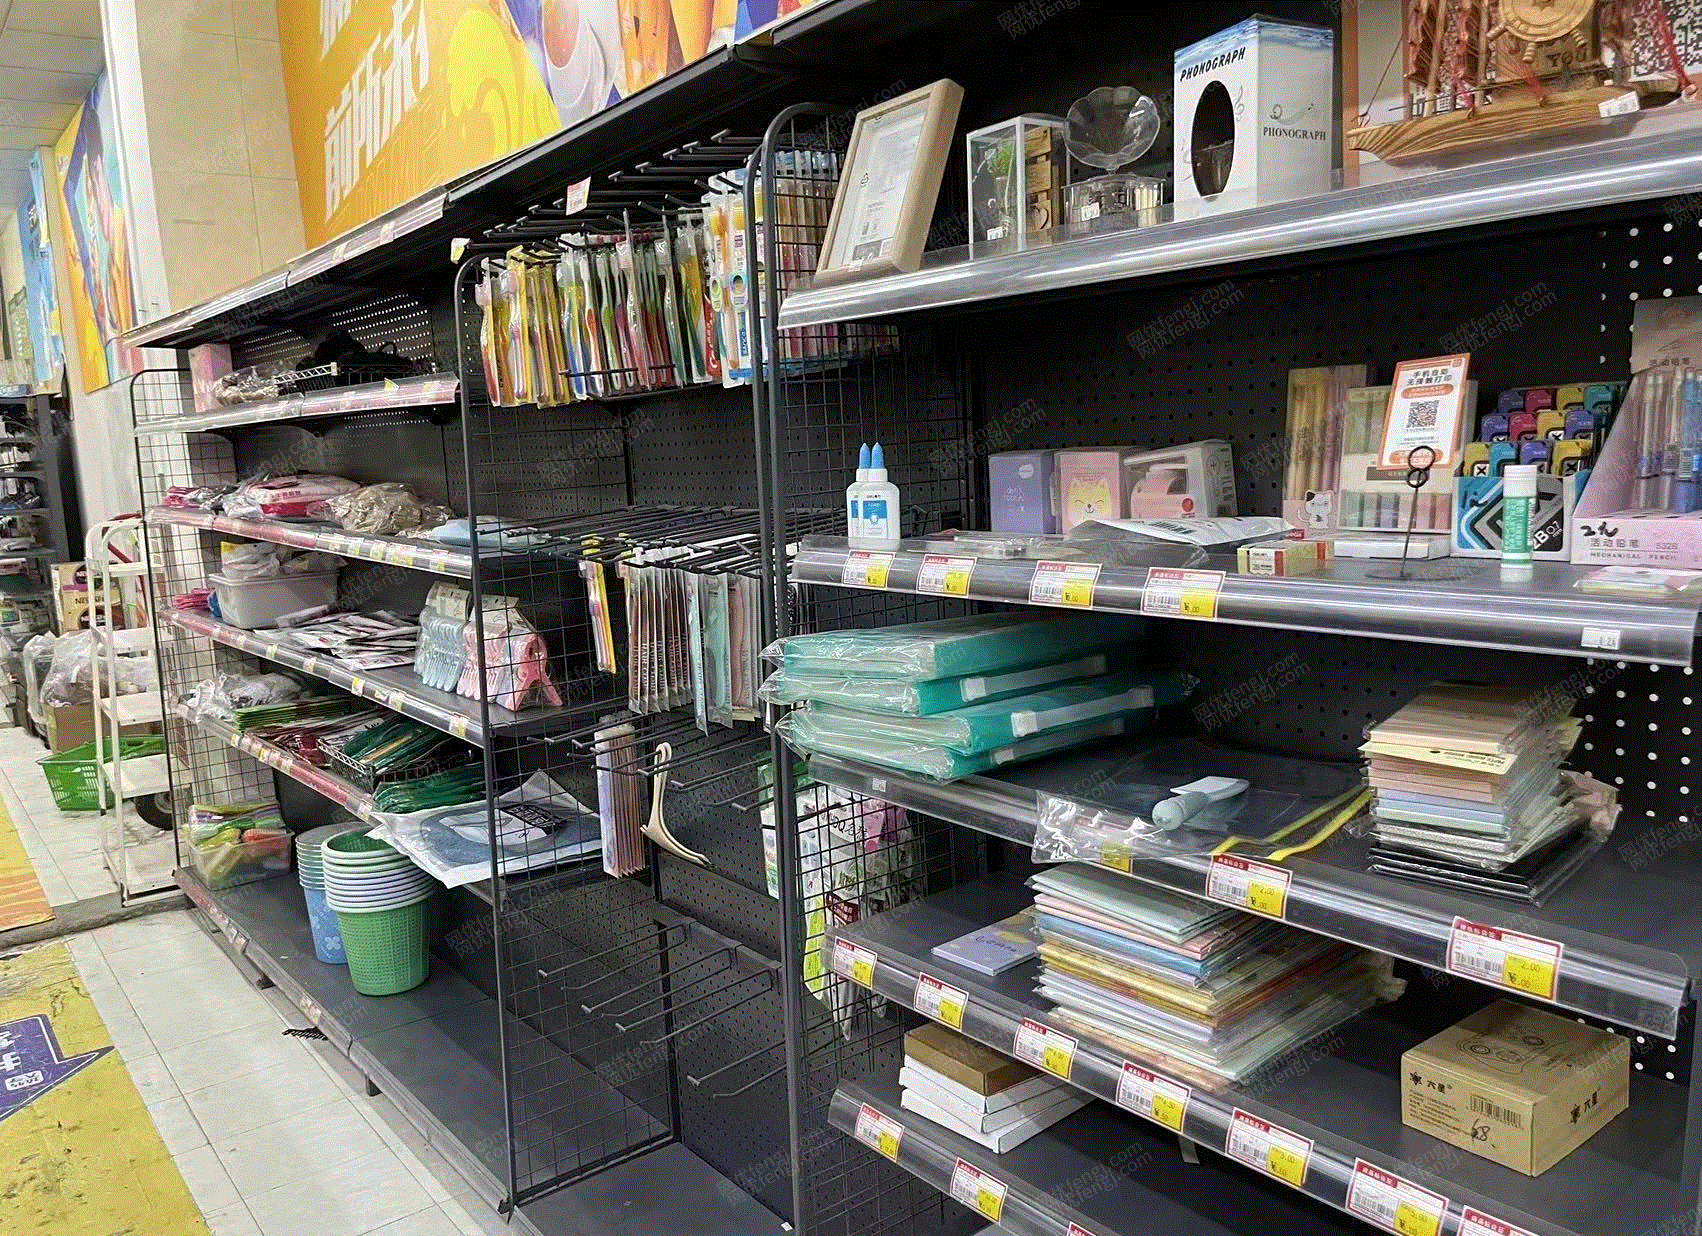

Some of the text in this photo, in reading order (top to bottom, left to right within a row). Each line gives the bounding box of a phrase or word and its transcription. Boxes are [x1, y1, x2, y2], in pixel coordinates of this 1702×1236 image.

[1179, 46, 1246, 82] PHONOGRAPH
[1263, 126, 1326, 141] PHONOGRAPH
[1590, 538, 1639, 548] 活动铅笔
[1590, 552, 1641, 560] MECHANICAL
[1426, 1080, 1446, 1094] 六星
